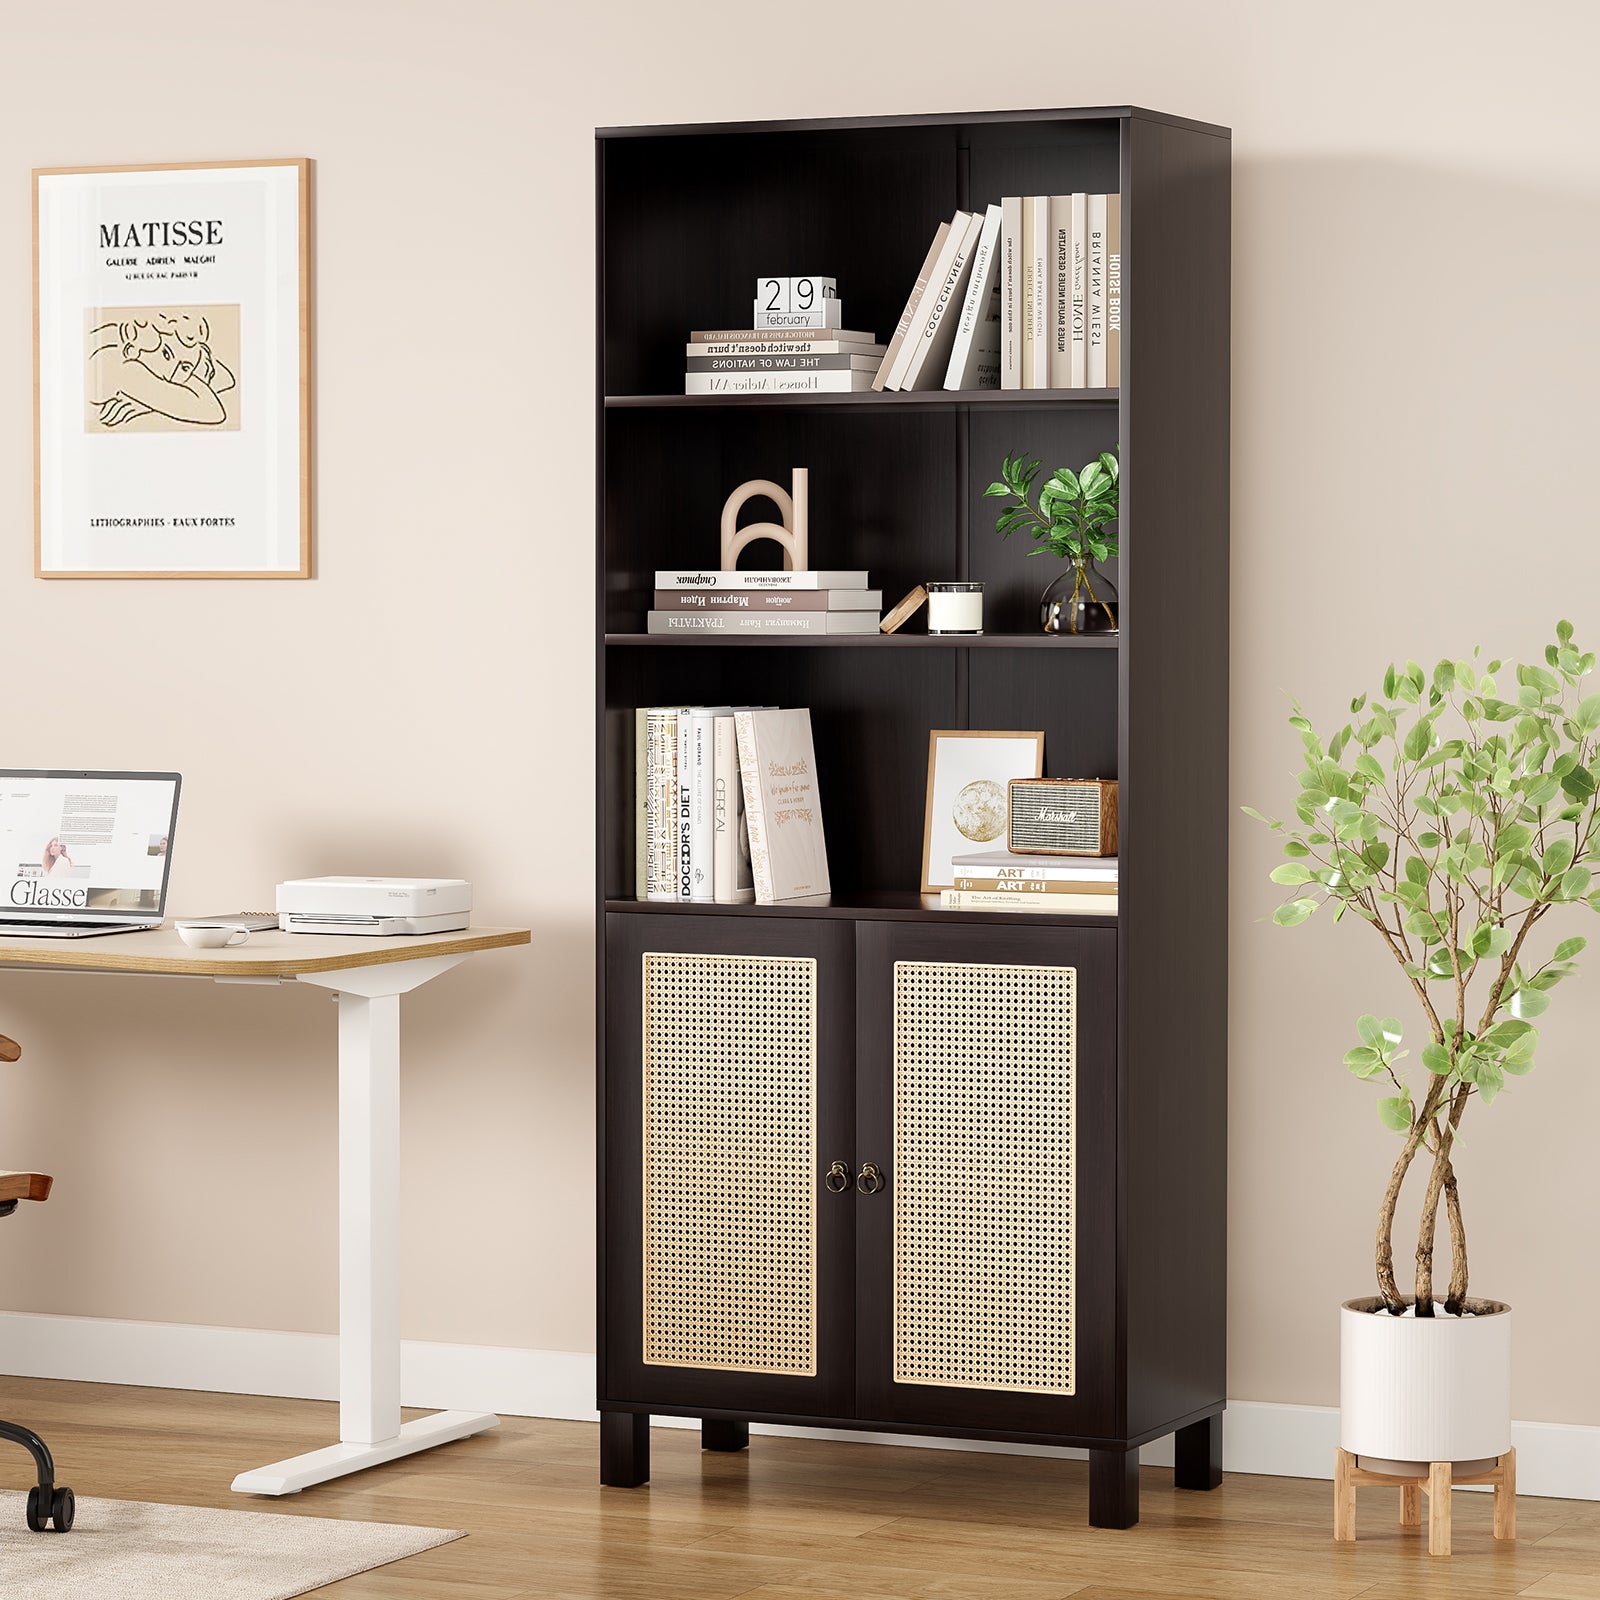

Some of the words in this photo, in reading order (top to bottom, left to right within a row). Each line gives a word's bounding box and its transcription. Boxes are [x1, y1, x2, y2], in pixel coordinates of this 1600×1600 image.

[100, 220, 223, 248] MATISSE
[766, 313, 810, 327] february
[90, 518, 165, 527] LITHOGRAPHIES
[173, 518, 198, 527] EAUX
[200, 517, 235, 527] FORTES
[676, 573, 717, 586] Спартак
[680, 596, 706, 607] Иден
[710, 596, 749, 607] Мартин
[668, 617, 725, 628] ТРАКТАТЫ
[680, 785, 690, 818] DIET
[1034, 807, 1077, 823] Marshall
[997, 868, 1025, 878] ART
[996, 881, 1026, 891] ART
